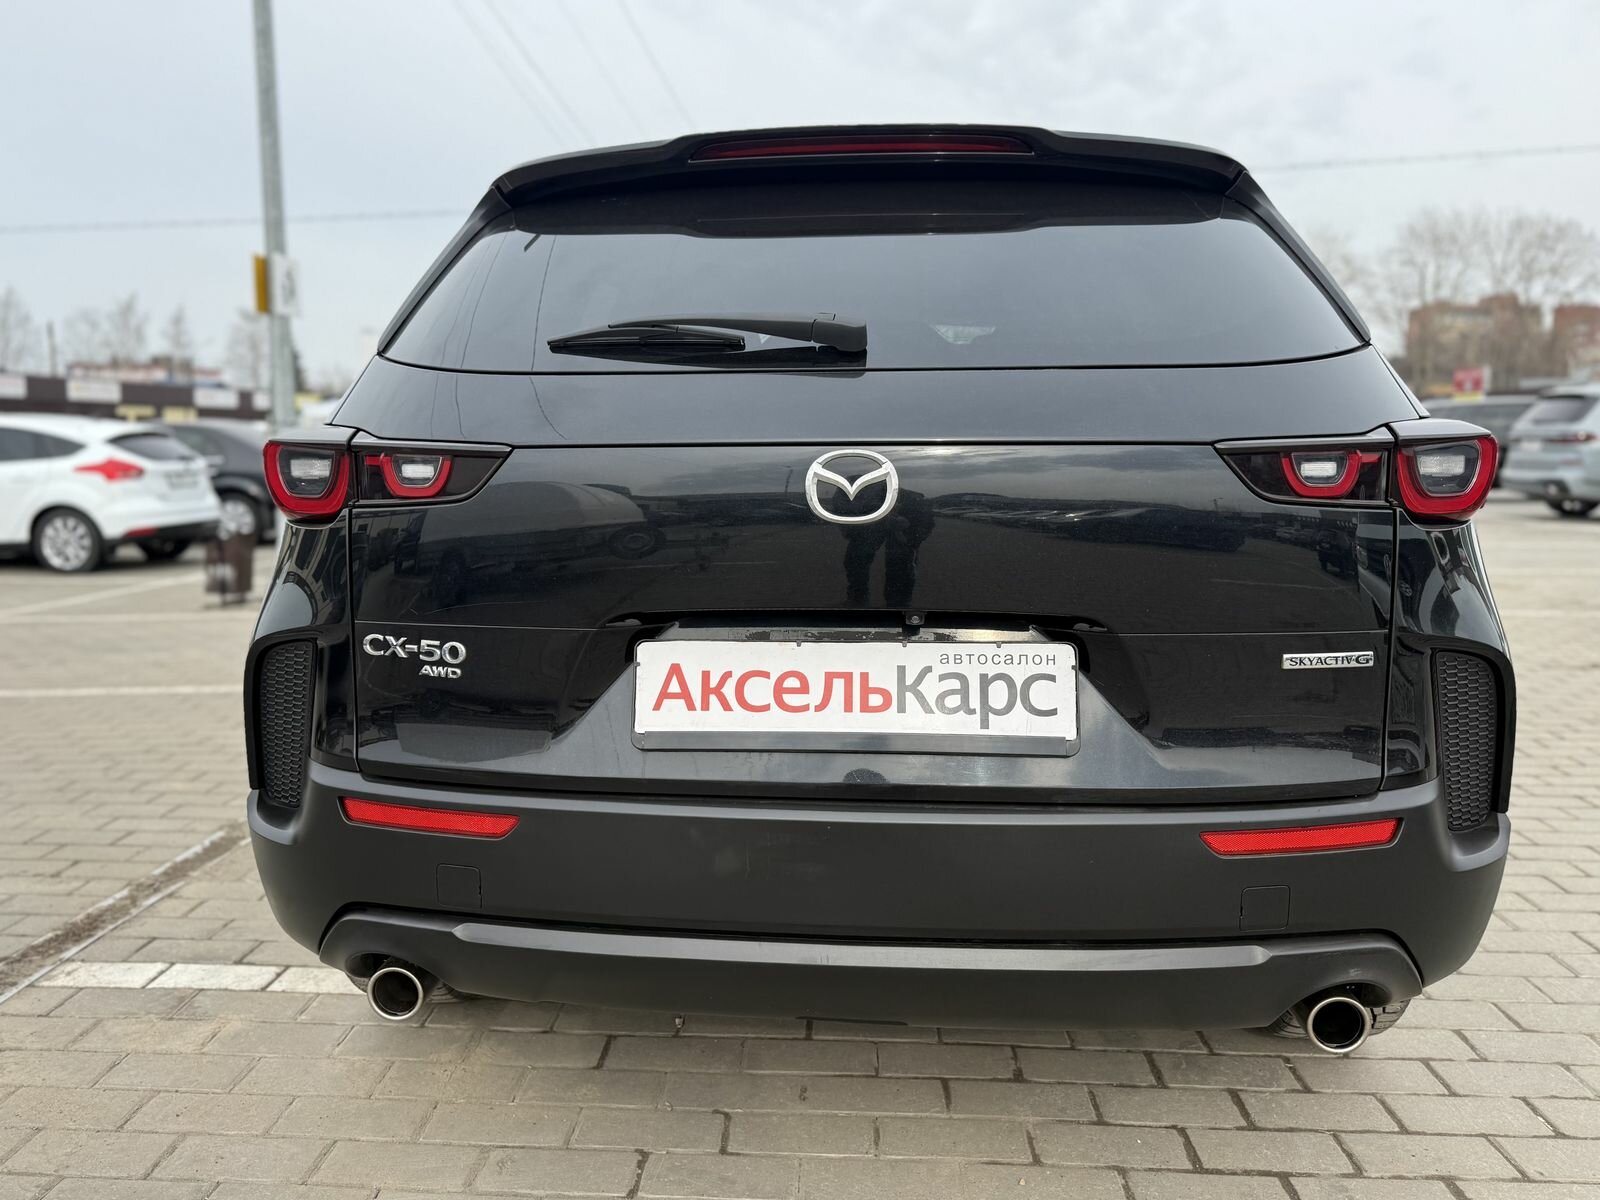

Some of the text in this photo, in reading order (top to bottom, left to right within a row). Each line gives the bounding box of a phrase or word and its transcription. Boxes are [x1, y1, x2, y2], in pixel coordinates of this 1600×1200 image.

[362, 633, 466, 664] CX-50
[939, 651, 1057, 667] автосалон
[419, 664, 462, 679] AWD
